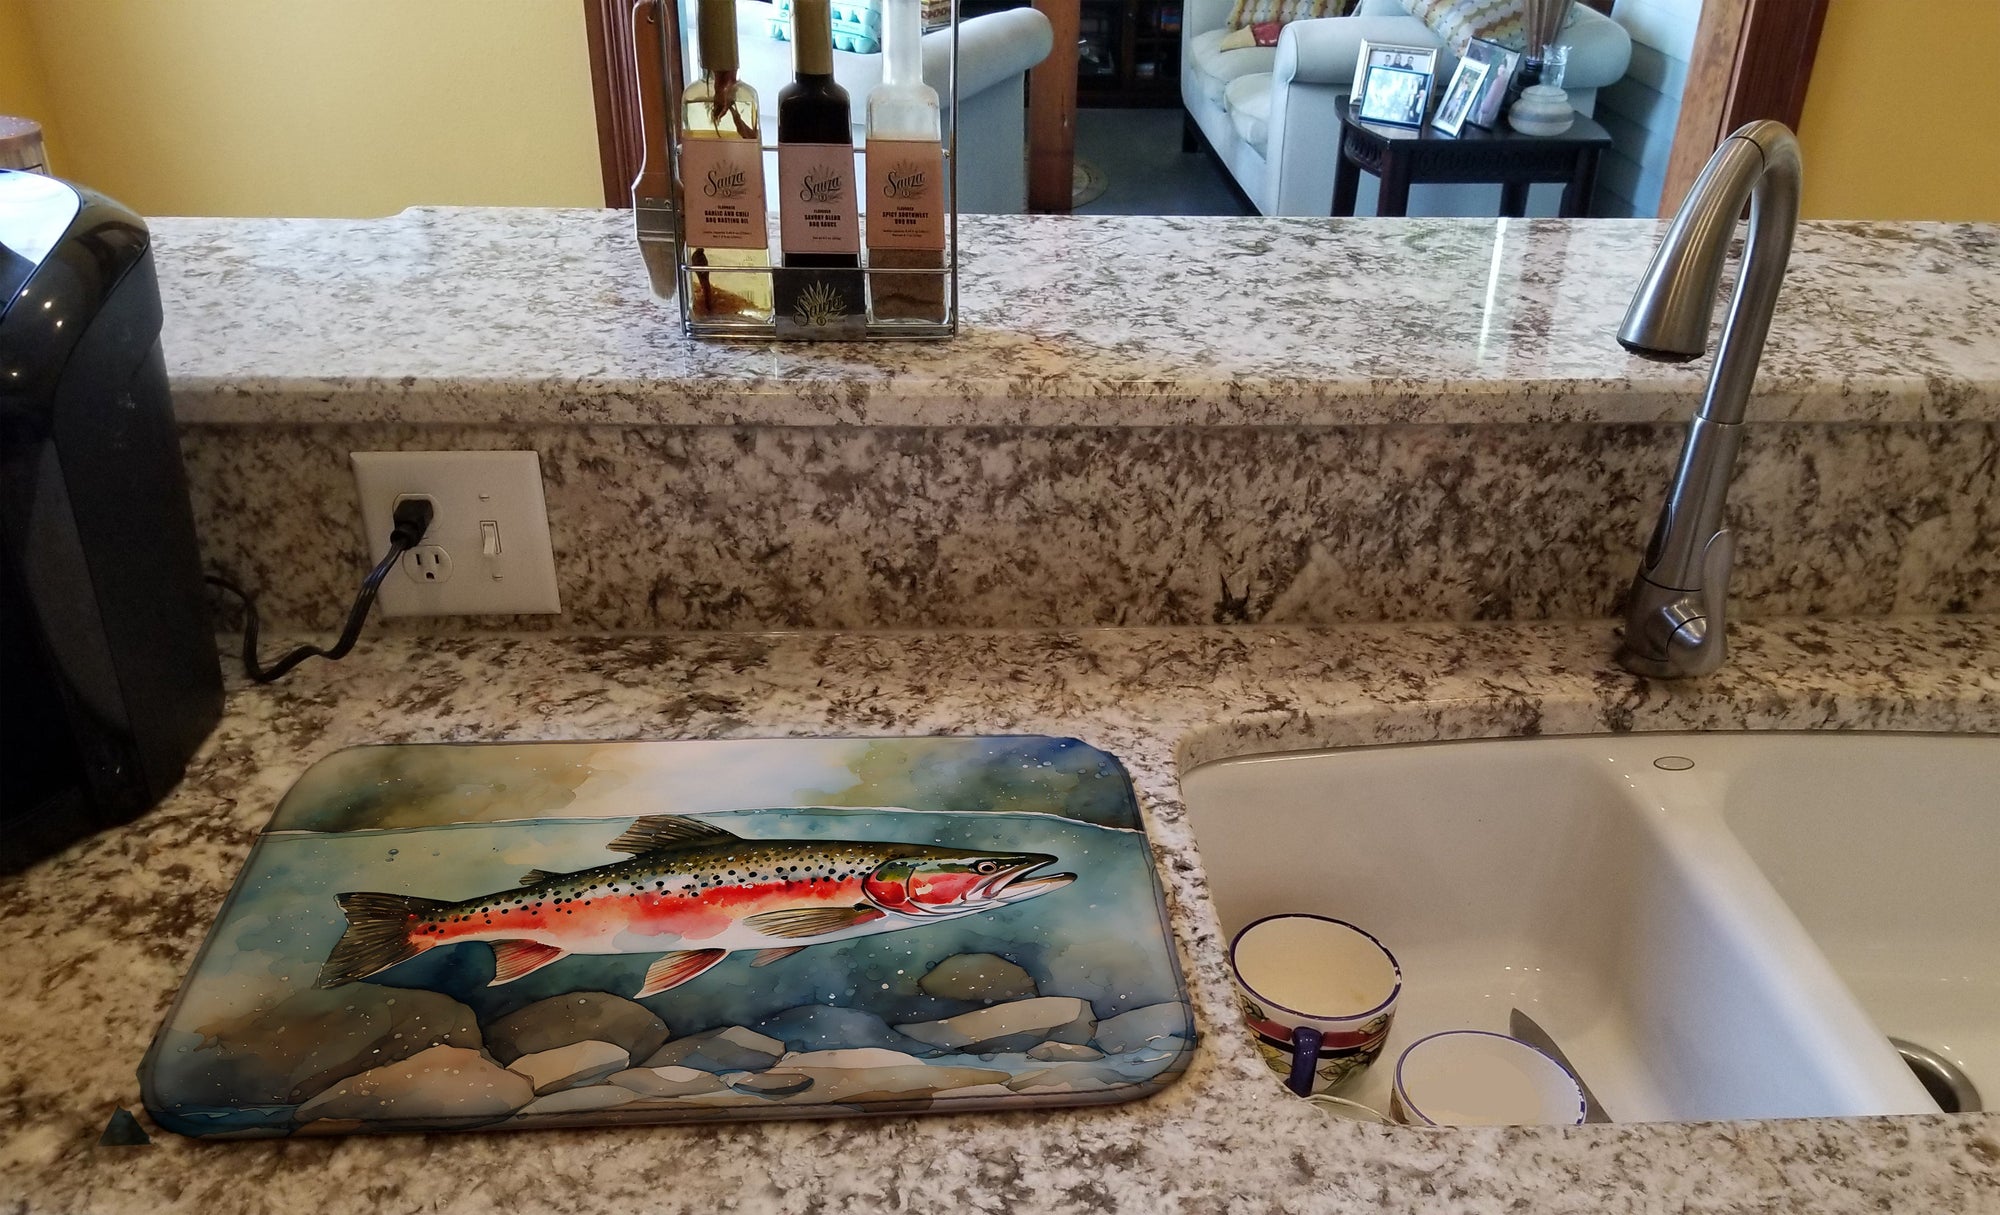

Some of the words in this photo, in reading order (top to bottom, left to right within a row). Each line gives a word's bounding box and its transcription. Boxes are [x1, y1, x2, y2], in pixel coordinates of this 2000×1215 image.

[704, 169, 746, 197] Sauza
[800, 175, 842, 202] Sauza
[884, 171, 926, 198] Sauza
[793, 294, 847, 327] Sauza
